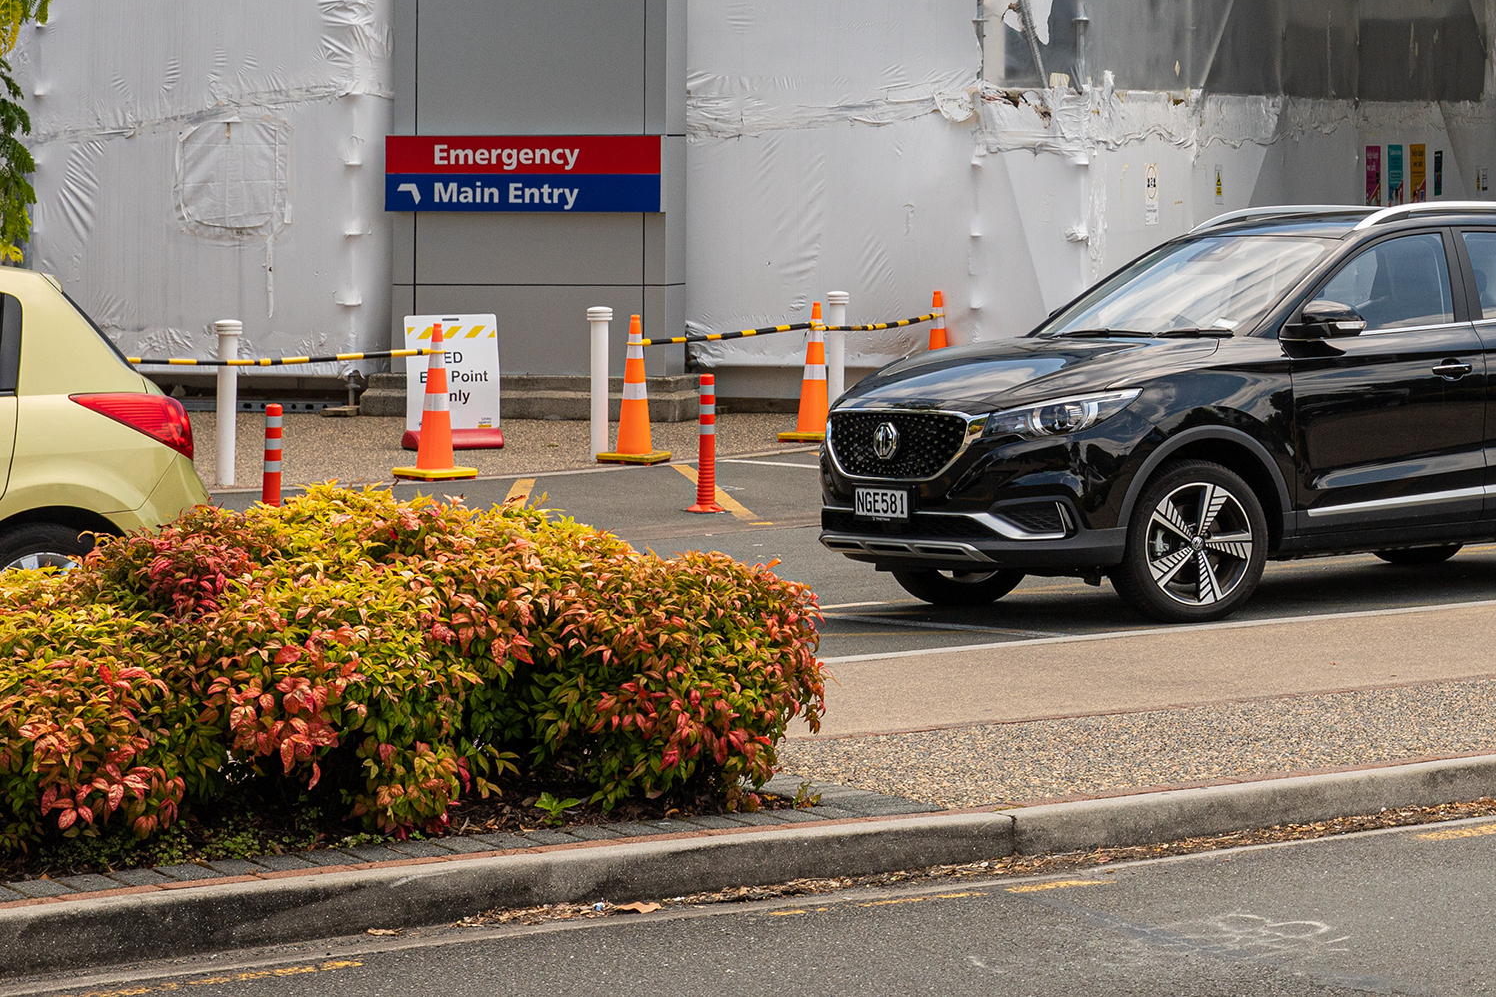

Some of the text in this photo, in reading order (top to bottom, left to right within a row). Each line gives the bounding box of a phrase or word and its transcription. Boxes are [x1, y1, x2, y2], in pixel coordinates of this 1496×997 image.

[433, 144, 580, 171] Emergency
[433, 181, 579, 210] Main Entry
[451, 370, 488, 383] Point
[449, 389, 471, 405] nly
[857, 491, 904, 514] NGE581
